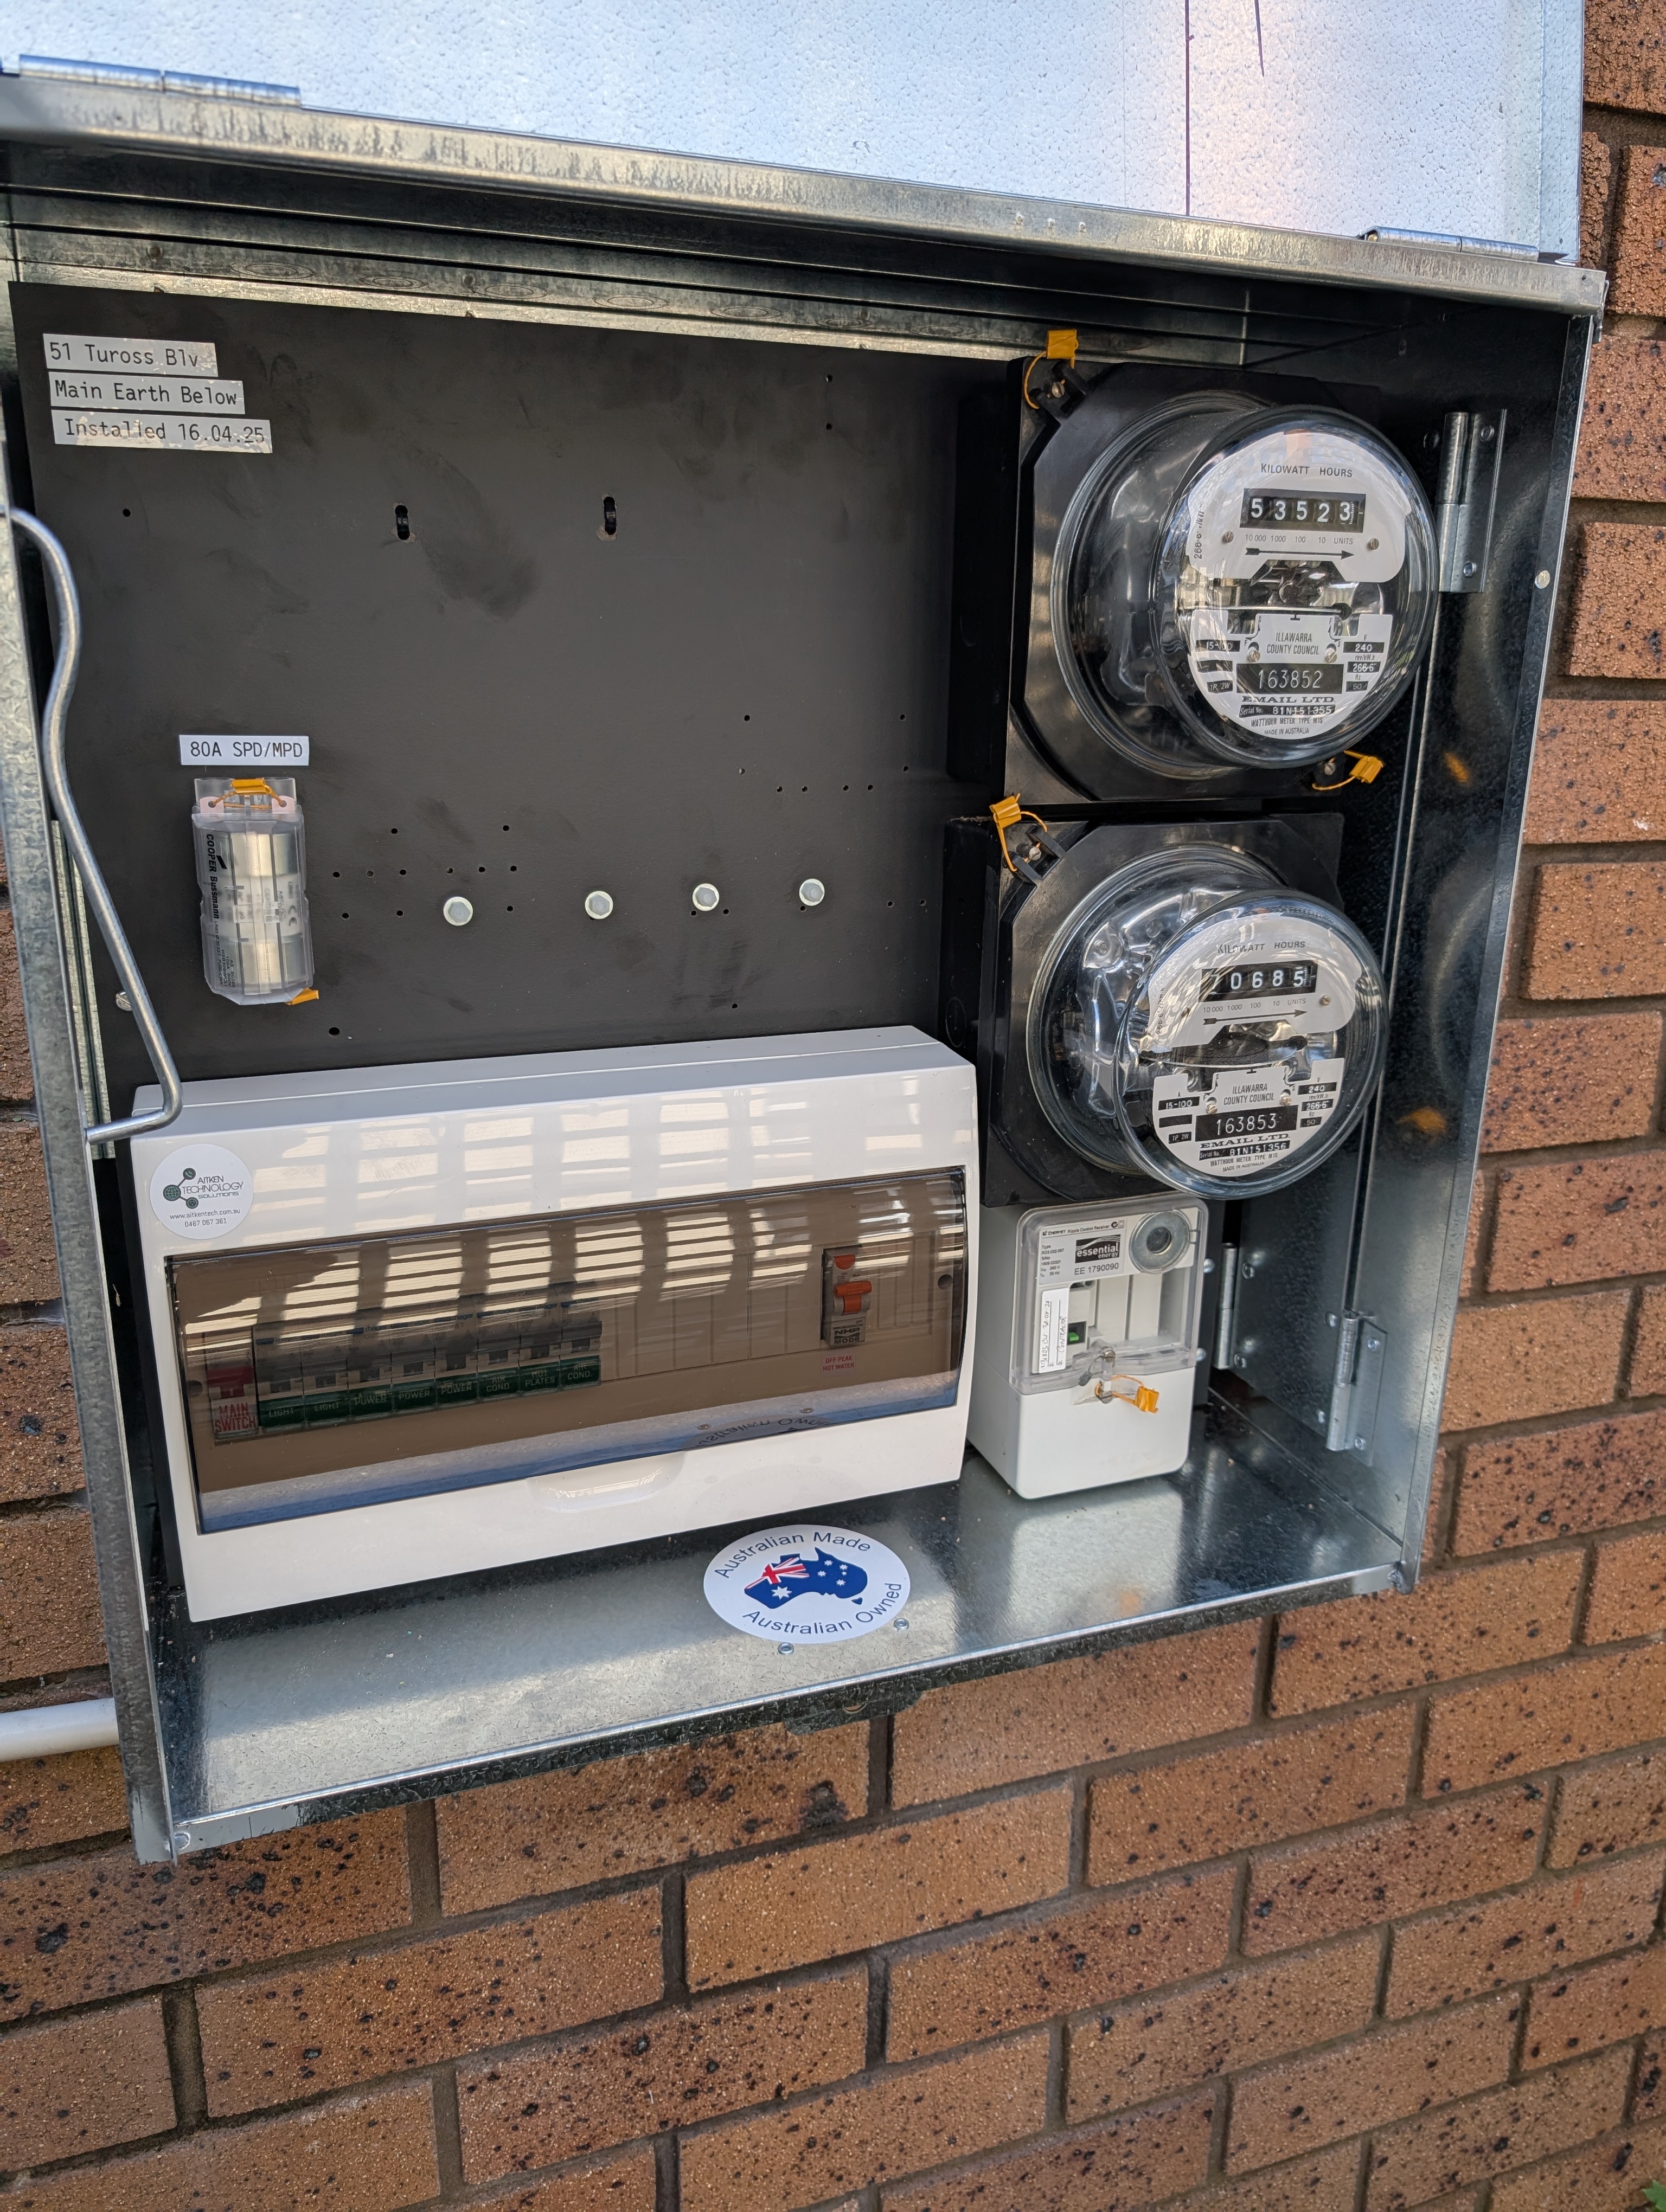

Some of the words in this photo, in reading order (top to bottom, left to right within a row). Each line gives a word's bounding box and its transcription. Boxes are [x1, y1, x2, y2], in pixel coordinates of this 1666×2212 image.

[50, 342, 71, 361] 51
[85, 344, 154, 365] Tuross
[166, 348, 198, 367] Blv
[55, 380, 102, 400] Main
[114, 383, 170, 402] Earth
[181, 386, 237, 406] Below
[65, 418, 166, 440] Installed
[178, 423, 265, 443] 16.04.25
[1260, 464, 1310, 475] KILOWATT
[1319, 467, 1353, 478] HOURS
[1276, 633, 1312, 643] ILLAWARRA
[1266, 644, 1292, 654] COUNTY
[1293, 645, 1319, 655] COUNCIL
[1355, 643, 1373, 652] 240
[1258, 670, 1323, 690] 163852
[1240, 707, 1254, 716] Serial
[1251, 717, 1277, 728] WATTHOUR
[190, 741, 222, 757] 80A
[233, 741, 303, 758] SPD/MPD
[206, 833, 217, 872] COOPER
[210, 876, 220, 919] Bussmann
[1217, 943, 1265, 954] KILOWATT
[1274, 941, 1306, 949] HOURS
[1232, 1083, 1267, 1095] ILLAWARRA
[1309, 1085, 1325, 1094] 240
[1165, 1099, 1193, 1109] 15-100
[1223, 1095, 1247, 1105] COUNTY
[1249, 1092, 1274, 1103] COUNCIL
[1216, 1113, 1277, 1136] 163853
[1200, 1137, 1253, 1149] EMAIL
[1200, 1150, 1213, 1159] Serial
[1229, 1142, 1286, 1156] 81N151356
[1210, 1158, 1234, 1167] WATTHOUR
[197, 1175, 224, 1184] AITKEN
[182, 1181, 244, 1194] TECHNOLOGY
[170, 1209, 240, 1219] www.aitkentech.com.au
[1077, 1242, 1119, 1257] essential
[1074, 1267, 1085, 1275] EE
[1088, 1262, 1119, 1274] 1790090
[1056, 1316, 1067, 1352] CONTRACTOR
[492, 1375, 505, 1384] AIR
[532, 1369, 548, 1378] HOT
[525, 1376, 555, 1387] PLATES
[441, 1382, 472, 1394] POWER
[354, 1394, 387, 1405] POWER
[399, 1390, 431, 1400] POWER
[219, 1402, 248, 1419] MAIN
[269, 1408, 294, 1417] LIGHT
[315, 1402, 339, 1411] LIGHT
[214, 1415, 256, 1433] SWITCH
[714, 1534, 804, 1579] Australian
[813, 1531, 871, 1552] Made
[742, 1610, 853, 1635] Australian
[855, 1582, 902, 1624] Owned
